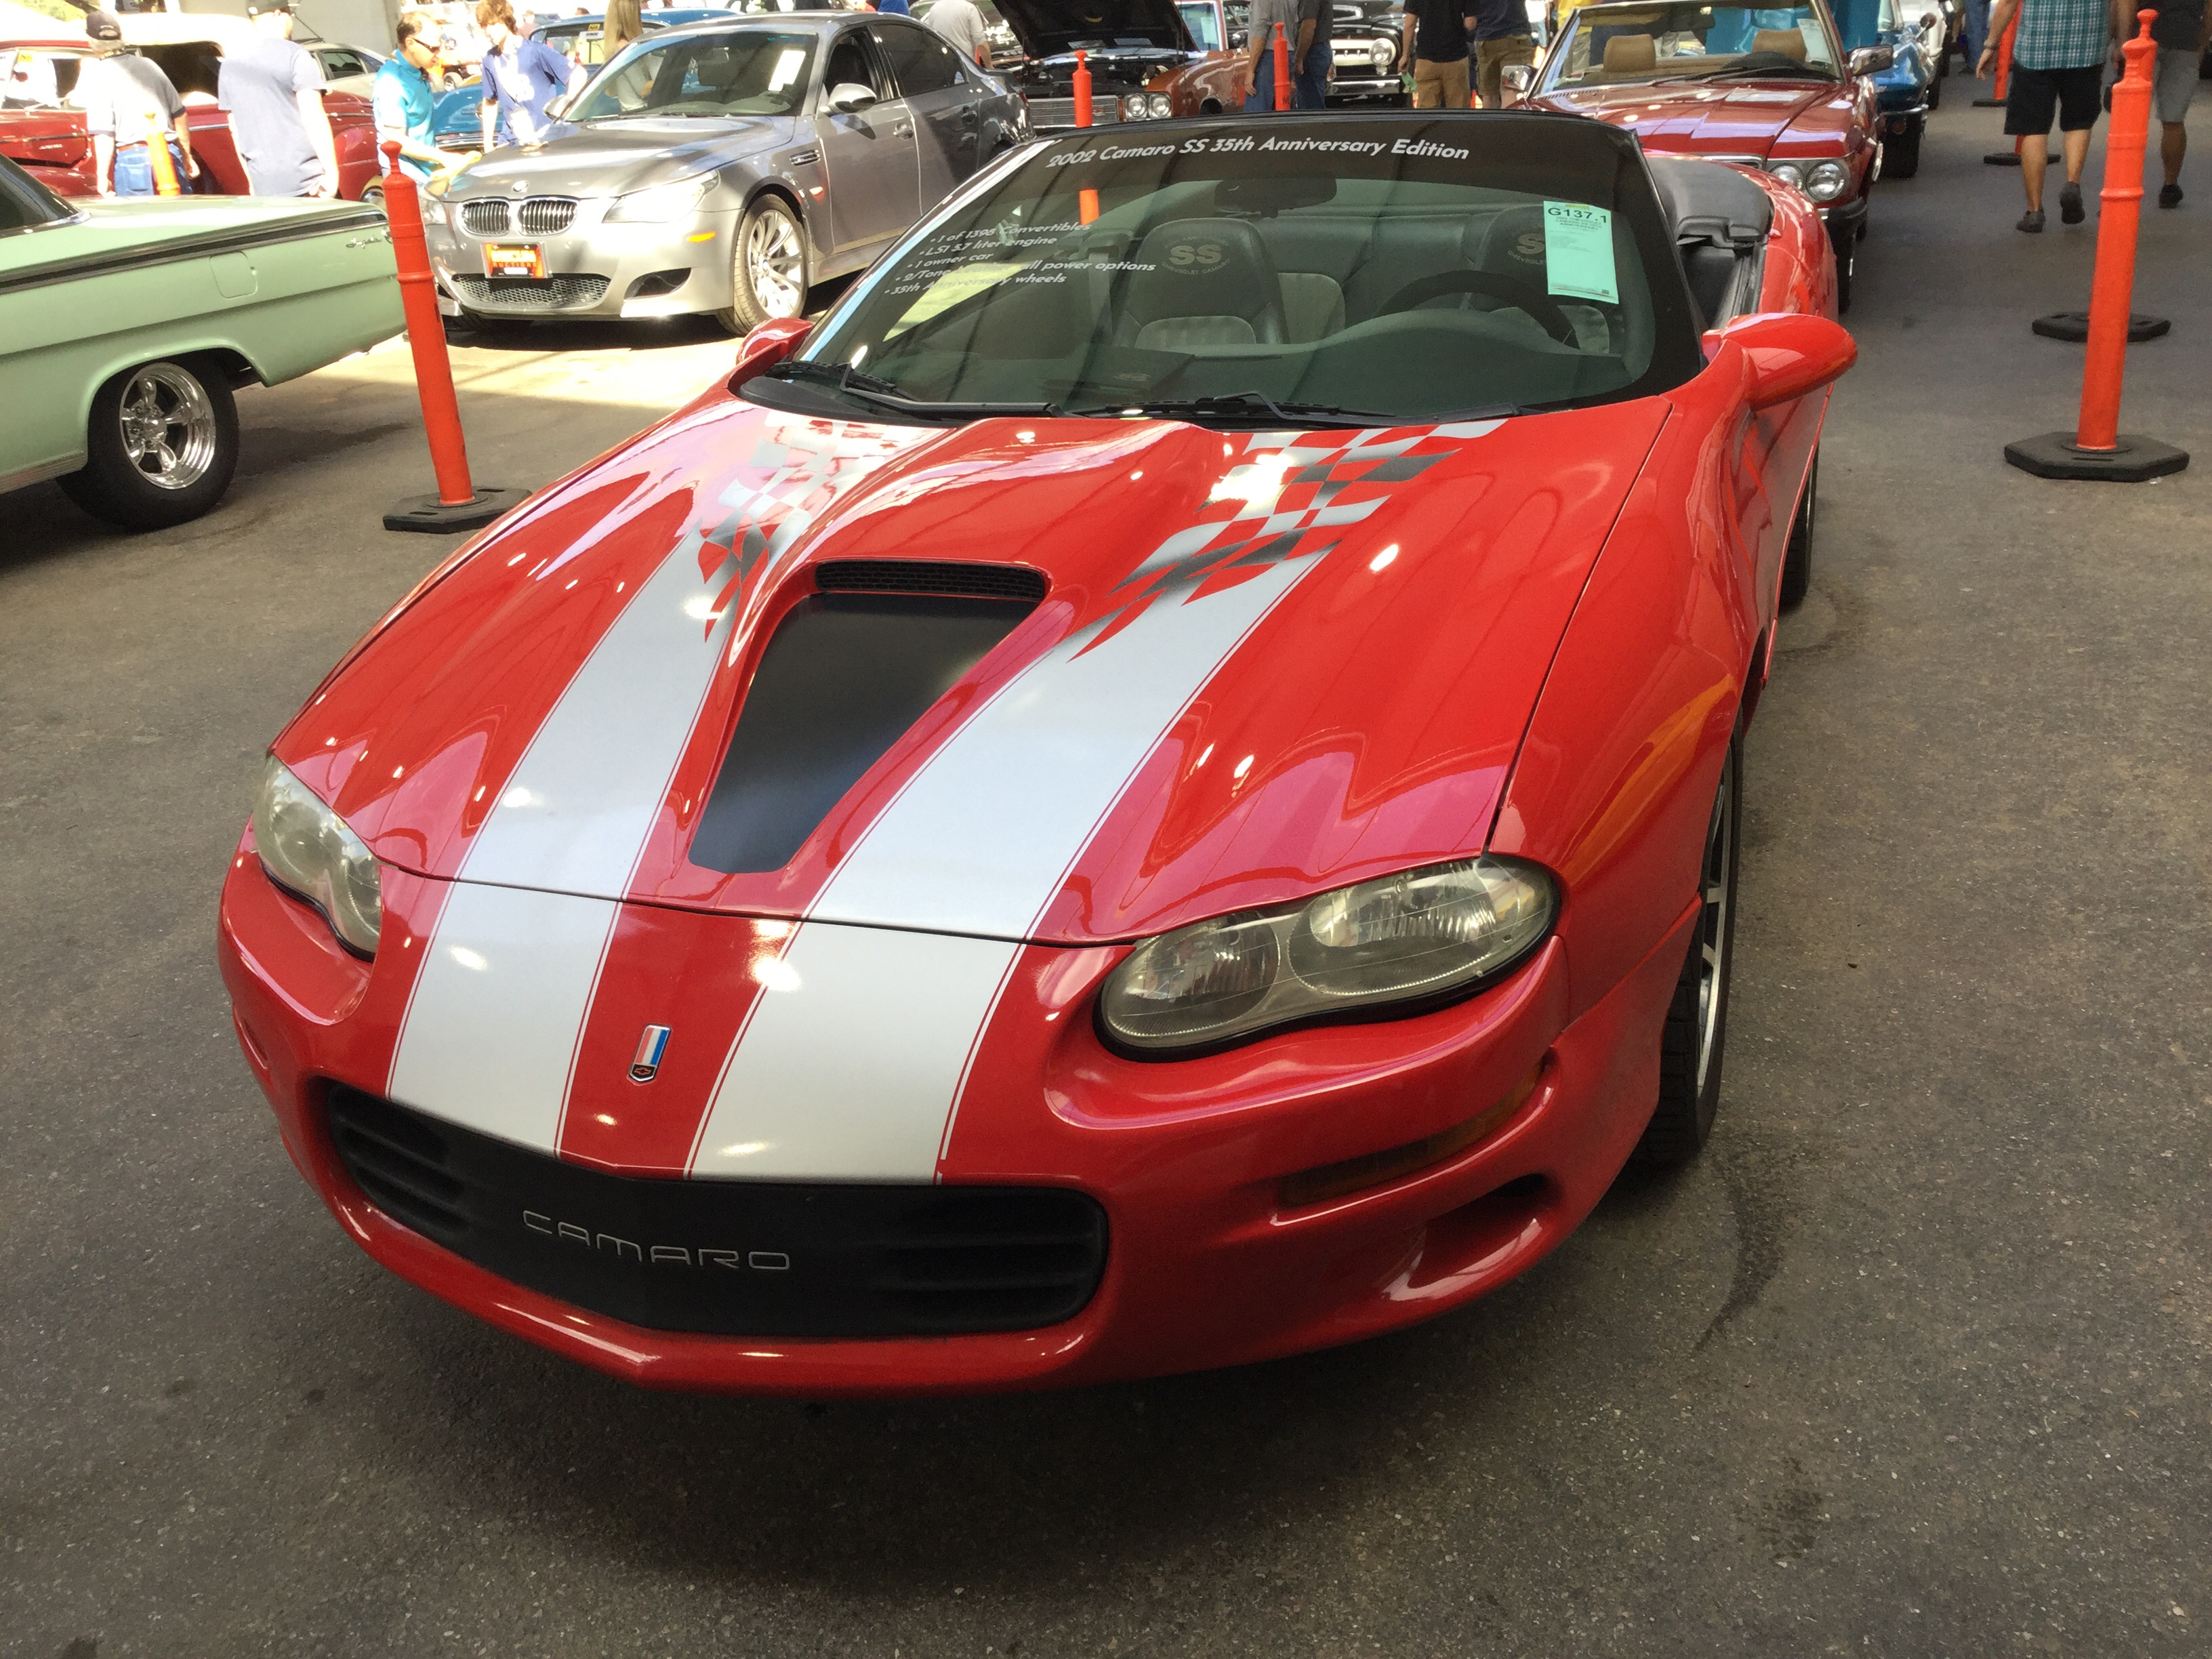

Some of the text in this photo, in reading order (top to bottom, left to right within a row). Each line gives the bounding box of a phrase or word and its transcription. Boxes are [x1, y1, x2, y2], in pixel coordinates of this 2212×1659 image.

[1045, 136, 1469, 168] 2002 Camaro SS 35th Anniversary Edition
[1548, 207, 1607, 223] G137.1
[937, 234, 945, 243] 1
[947, 230, 966, 242] of
[972, 239, 1003, 249] liter
[1004, 237, 1057, 247] engine
[915, 252, 994, 268] 1 owner car
[1169, 244, 1222, 265] SS
[1041, 261, 1092, 271] power
[1095, 262, 1156, 271] options
[890, 283, 922, 295] 35th
[1015, 273, 1067, 283] wheels
[523, 1210, 790, 1270] CAMARO
